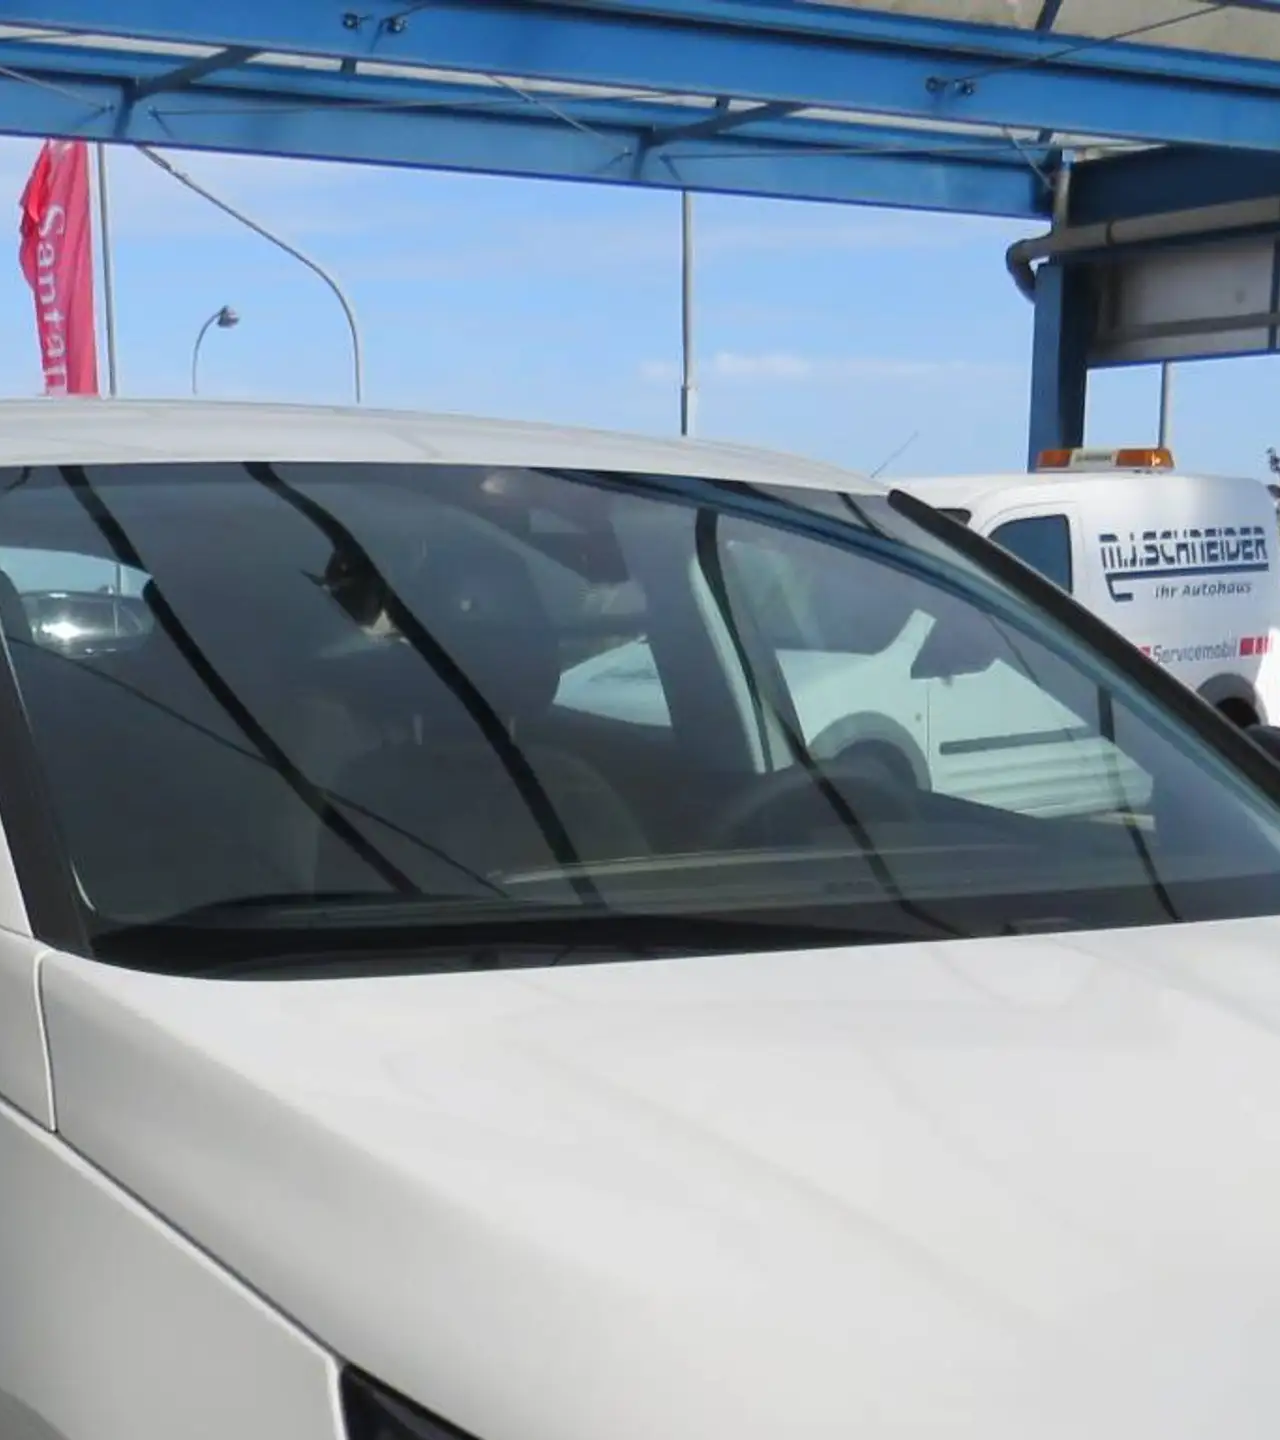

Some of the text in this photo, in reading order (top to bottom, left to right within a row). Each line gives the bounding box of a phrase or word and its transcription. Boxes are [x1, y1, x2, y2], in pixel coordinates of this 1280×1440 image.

[1155, 581, 1252, 598] Ihr Autohaus
[1152, 638, 1238, 663] Servicemobil
